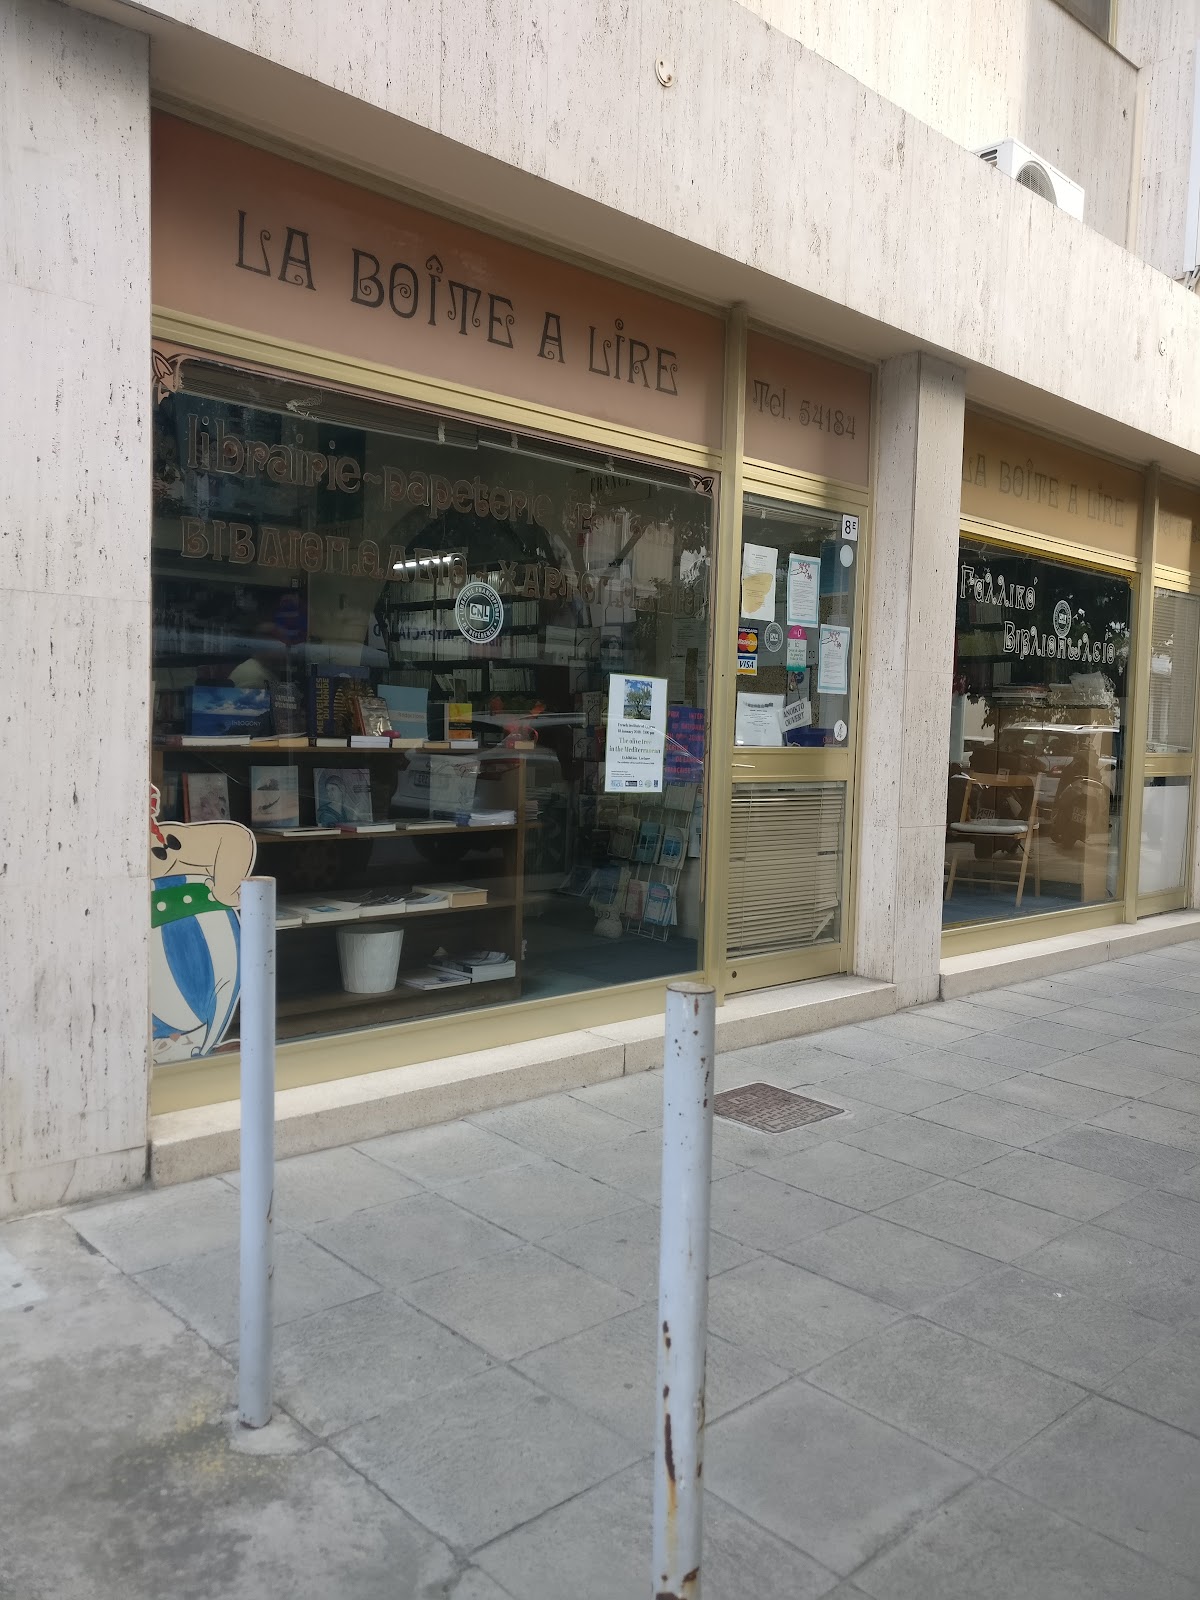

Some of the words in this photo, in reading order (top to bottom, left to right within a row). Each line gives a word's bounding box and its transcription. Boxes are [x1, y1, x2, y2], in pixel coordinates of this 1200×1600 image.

[234, 210, 317, 291] LA
[349, 247, 516, 350] BOÎTE
[537, 311, 566, 364] A
[588, 317, 678, 396] LIRE
[753, 379, 791, 421] Tel.
[799, 399, 856, 440] 54184
[1067, 482, 1078, 515] A
[1087, 481, 1124, 528] LIRE
[471, 605, 489, 619] CNL
[739, 660, 754, 669] VISA
[316, 677, 324, 735] MERVEILLES
[323, 709, 330, 720] DU
